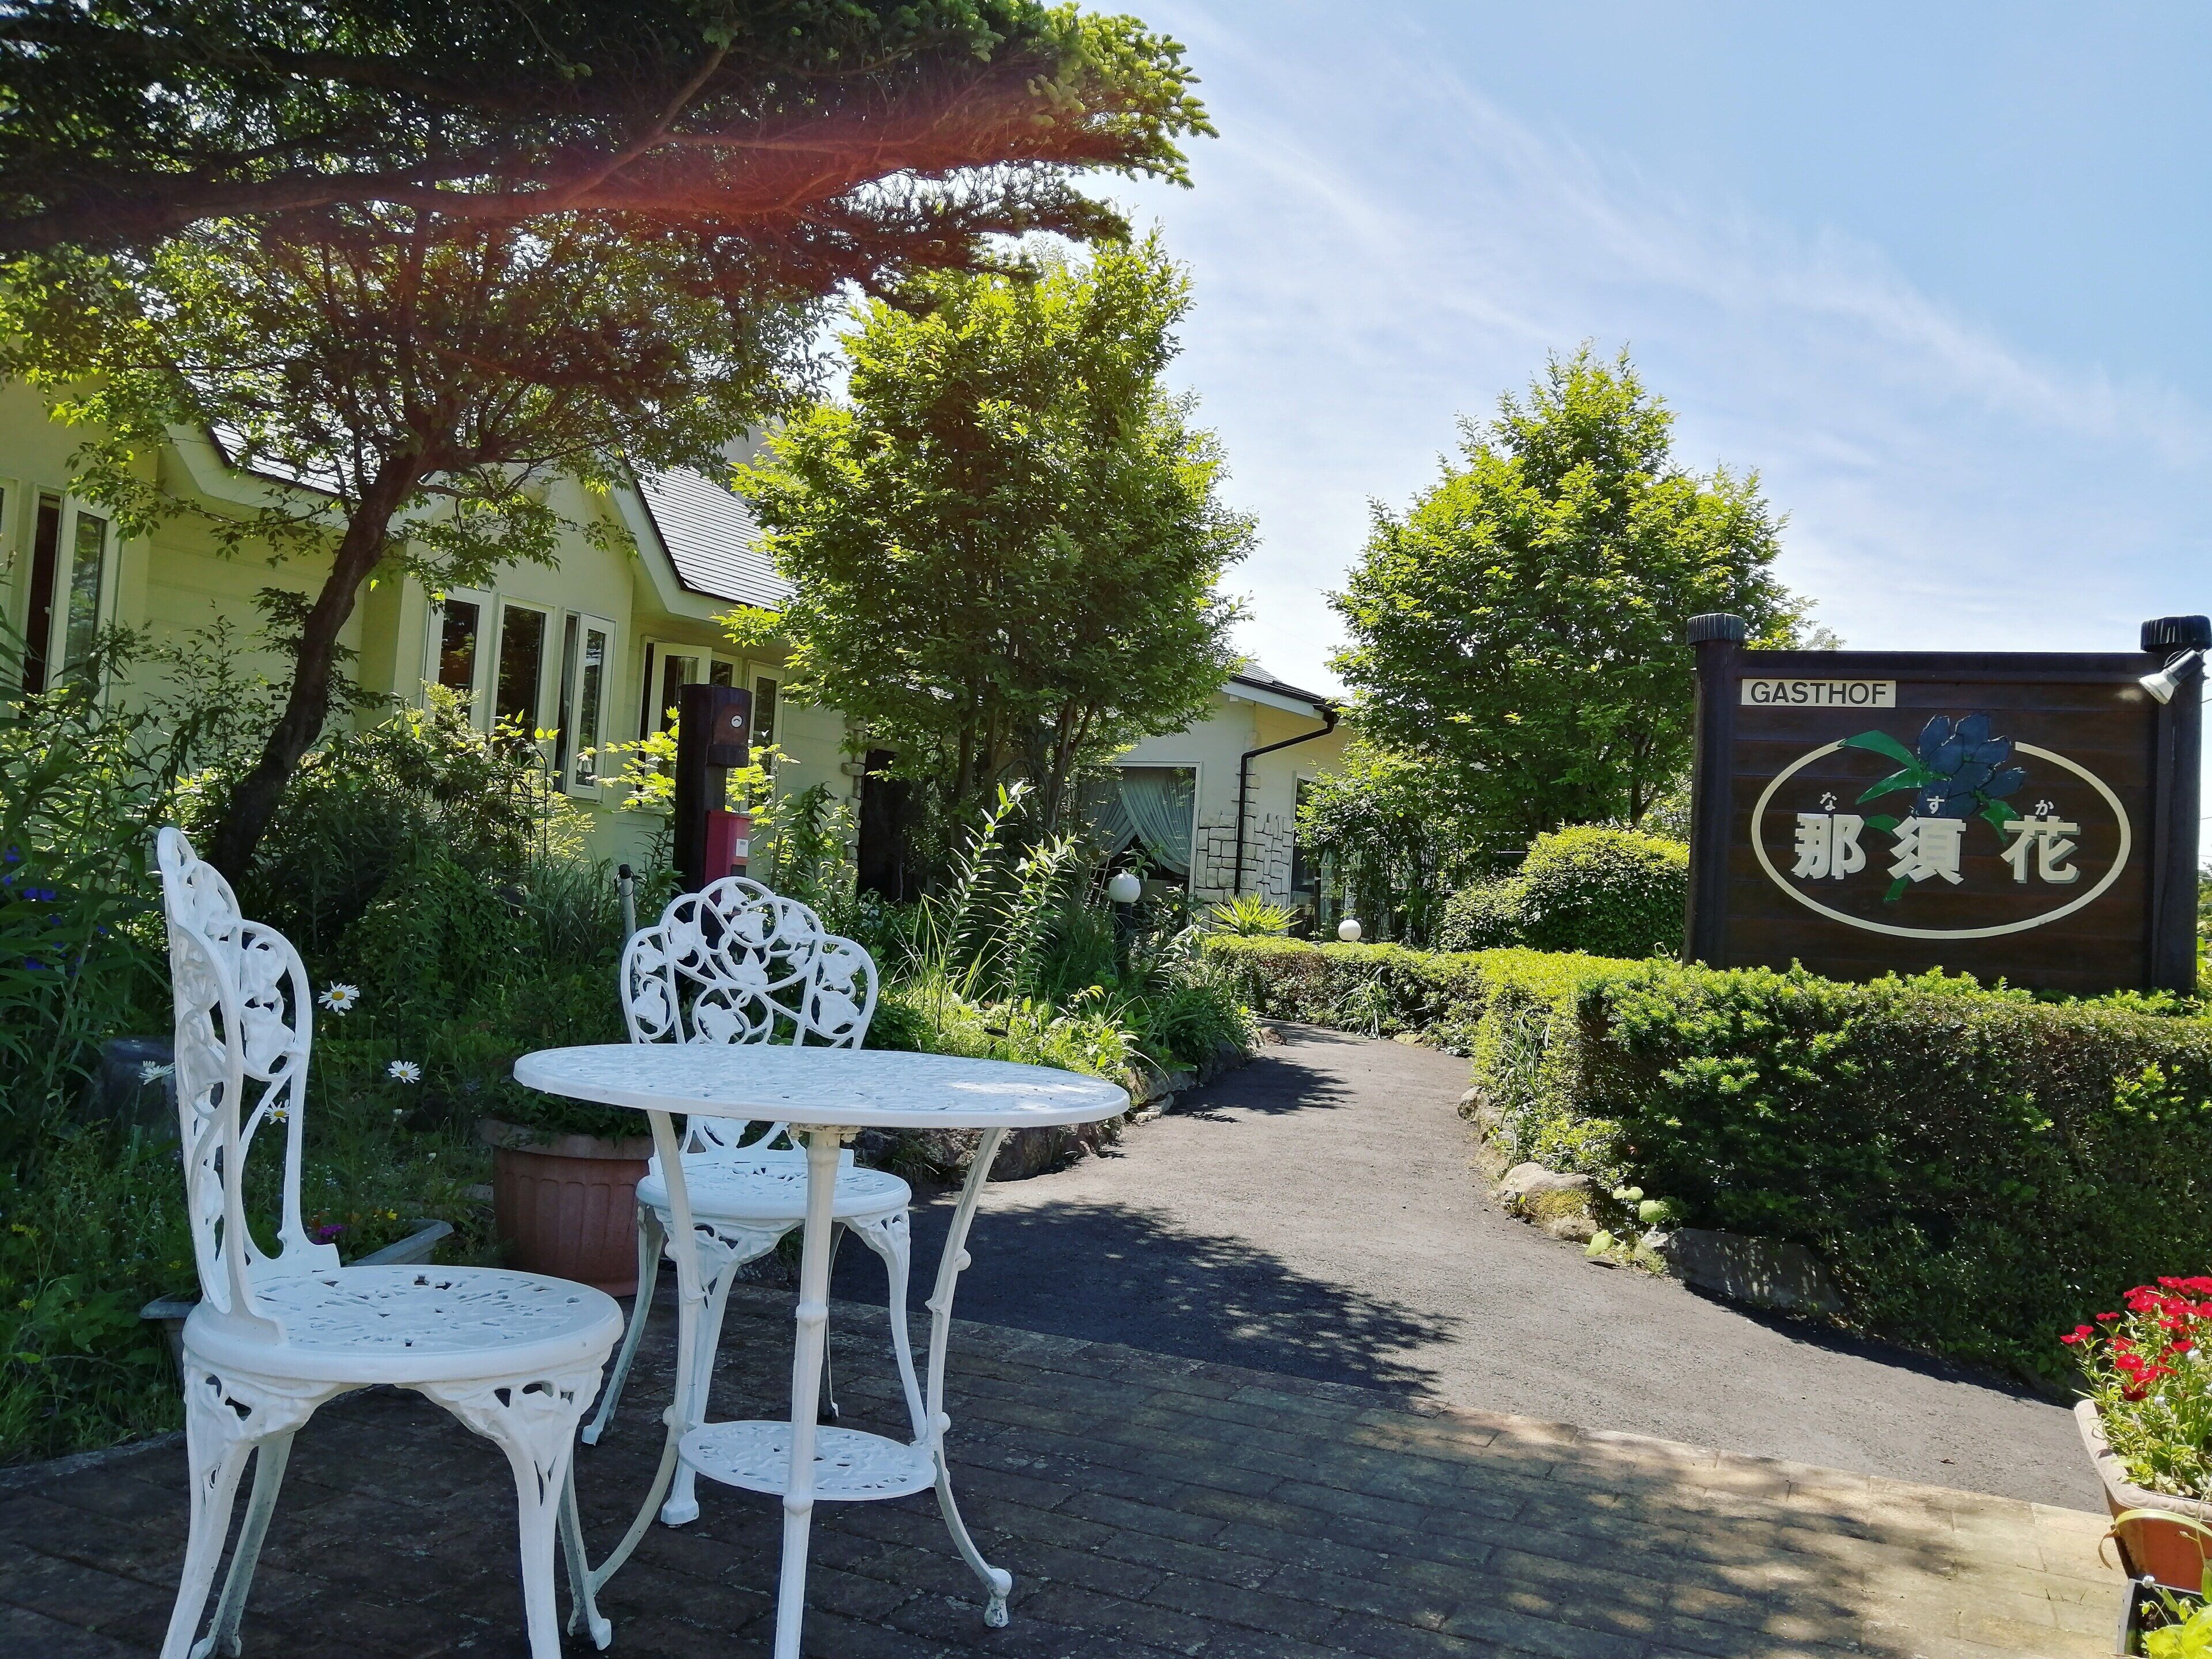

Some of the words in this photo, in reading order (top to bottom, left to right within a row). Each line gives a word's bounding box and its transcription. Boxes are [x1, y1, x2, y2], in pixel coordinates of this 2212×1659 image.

[1751, 681, 1887, 704] GASTHOF
[1791, 813, 2081, 885] 那須花
